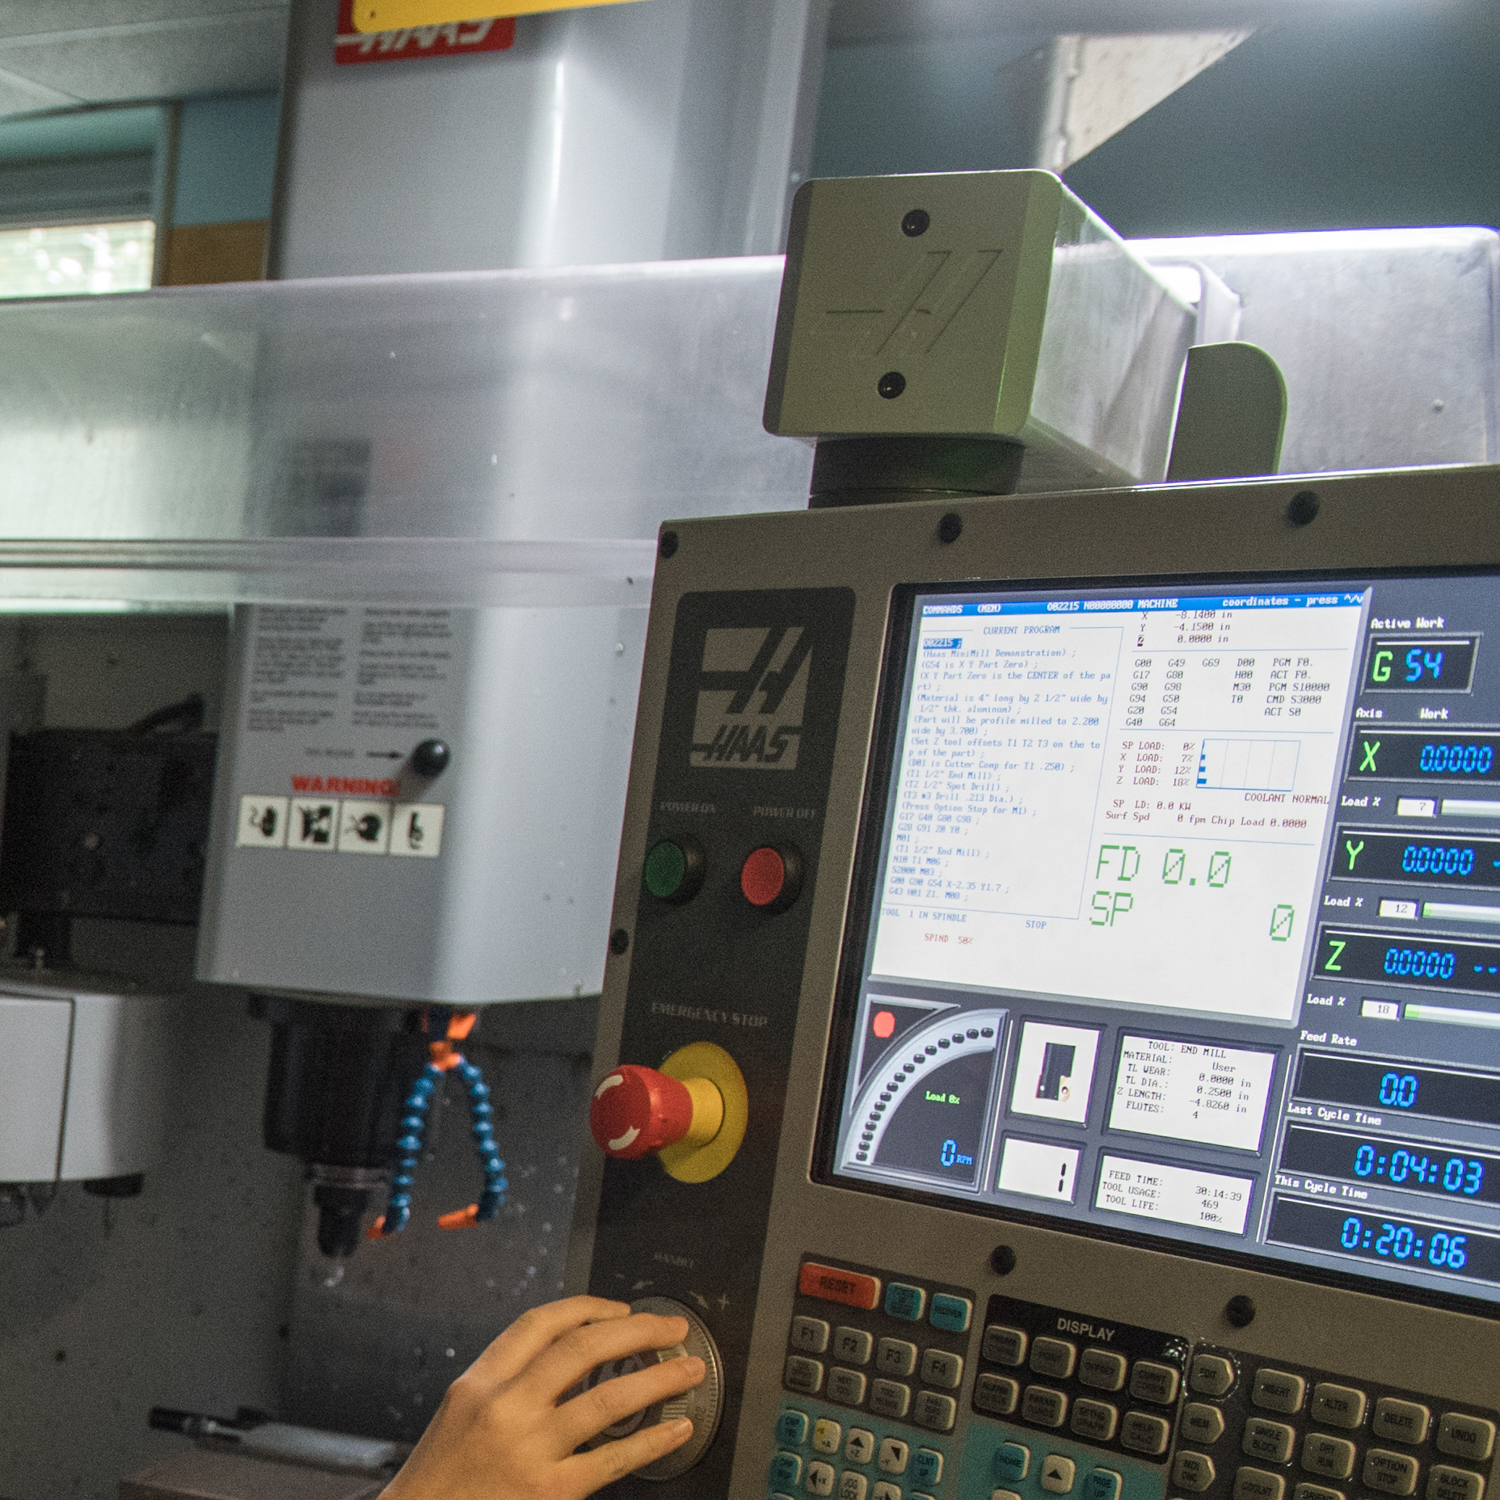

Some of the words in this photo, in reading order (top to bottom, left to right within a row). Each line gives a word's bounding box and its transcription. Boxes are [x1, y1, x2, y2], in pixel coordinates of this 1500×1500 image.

[923, 605, 963, 614] COMMANDS
[977, 604, 1001, 613] (MEM)
[1138, 599, 1178, 608] MACHINE
[1223, 597, 1289, 606] coordinates
[1306, 596, 1338, 606] press
[983, 627, 1018, 635] CURRENT
[1023, 625, 1060, 634] PROGRAM
[1371, 618, 1411, 629] Active
[1416, 616, 1444, 628] Work
[1372, 651, 1393, 682] G
[1405, 647, 1444, 682] 54
[1356, 708, 1383, 718] Axis
[1420, 708, 1448, 719] Work
[690, 725, 800, 763] HAAS
[1122, 741, 1133, 750] SP
[1139, 742, 1165, 751] LOAD:
[1183, 742, 1195, 750] 0%
[1120, 753, 1127, 761] X
[1136, 753, 1163, 763] LOAD:
[1182, 754, 1193, 763] 7%
[1359, 741, 1380, 772] X
[1420, 744, 1494, 774] 0.0000
[1119, 765, 1124, 773] Y
[1135, 765, 1162, 774] LOAD:
[1175, 766, 1191, 774] 12%
[1117, 776, 1123, 785] Z
[1133, 777, 1160, 786] LOAD:
[1173, 777, 1189, 787] 18%
[1244, 792, 1287, 803] COOLANT
[1292, 794, 1329, 805] NORMAL
[1341, 796, 1367, 807] Load
[1372, 797, 1381, 806] %
[1420, 803, 1426, 811] 7
[1096, 844, 1141, 881] FD
[1162, 848, 1232, 888] 0.0
[1346, 840, 1364, 870] Y
[1402, 845, 1475, 875] 0.0000
[1324, 895, 1350, 907] Load
[1355, 897, 1363, 907] %
[1395, 904, 1408, 914] 12
[881, 908, 900, 917] TOOL
[910, 910, 914, 918] 1
[919, 911, 929, 920] IN
[932, 912, 967, 922] SPINDLE
[1025, 920, 1047, 930] STOP
[1089, 891, 1134, 927] SP
[1269, 904, 1295, 941] 0
[924, 933, 949, 943] SPIND
[957, 936, 974, 944] 50%
[1325, 940, 1346, 971] Z
[1384, 947, 1456, 979] 0.0000
[1307, 993, 1333, 1005] Load
[1338, 997, 1346, 1006] %
[1378, 1004, 1389, 1014] 18
[651, 1002, 728, 1023] EMERGENCY
[731, 1012, 768, 1027] STOP
[1300, 1030, 1325, 1043] Feed
[1331, 1033, 1357, 1046] Rate
[1148, 1041, 1175, 1052] TOOL:
[1181, 1045, 1198, 1054] END
[1203, 1048, 1226, 1059] MILL
[1123, 1051, 1172, 1064] MATERIAL:
[1212, 1062, 1236, 1073] User
[1128, 1063, 1137, 1073] TL
[1143, 1065, 1170, 1076] WEAR:
[1199, 1073, 1233, 1085] 0.0000
[1241, 1079, 1251, 1088] in
[925, 1091, 946, 1103] Load
[949, 1093, 960, 1104] 0%
[1126, 1076, 1135, 1085] TL
[1141, 1078, 1168, 1088] DIA.:
[1197, 1086, 1231, 1098] 0.2500
[1238, 1092, 1249, 1100] in
[1379, 1071, 1419, 1108] 0.0
[1117, 1087, 1123, 1095] Z
[1128, 1089, 1166, 1101] LENGTH:
[1189, 1098, 1230, 1111] -4.8260
[1236, 1104, 1247, 1113] in
[1126, 1101, 1164, 1113] FLUTES:
[1193, 1111, 1199, 1119] 4
[1287, 1102, 1312, 1116] Last
[1318, 1107, 1350, 1121] Cycle
[1356, 1112, 1381, 1126] Time
[941, 1139, 957, 1167] 0
[956, 1154, 974, 1165] RPM
[1354, 1144, 1484, 1195] 0:04:03
[1103, 1182, 1123, 1192] TOOL
[1128, 1186, 1161, 1198] USAGE:
[1201, 1199, 1219, 1209] 469
[1109, 1170, 1131, 1181] FEED
[1137, 1175, 1163, 1186] TIME:
[1196, 1186, 1242, 1201] 30:14:39
[1274, 1174, 1299, 1188] This
[1305, 1179, 1337, 1193] Cycle
[1342, 1185, 1368, 1199] Time
[1106, 1194, 1126, 1206] TOOL
[1132, 1199, 1159, 1211] LIFE:
[1199, 1212, 1223, 1224] 100%
[1341, 1216, 1468, 1269] 0:20:06
[819, 1276, 856, 1294] RESET
[801, 1327, 814, 1341] F1
[1057, 1317, 1115, 1342] DISPLAY
[842, 1337, 858, 1351] F2
[886, 1348, 901, 1364] F3
[931, 1360, 946, 1375] F4
[1451, 1428, 1477, 1443] UNDO
